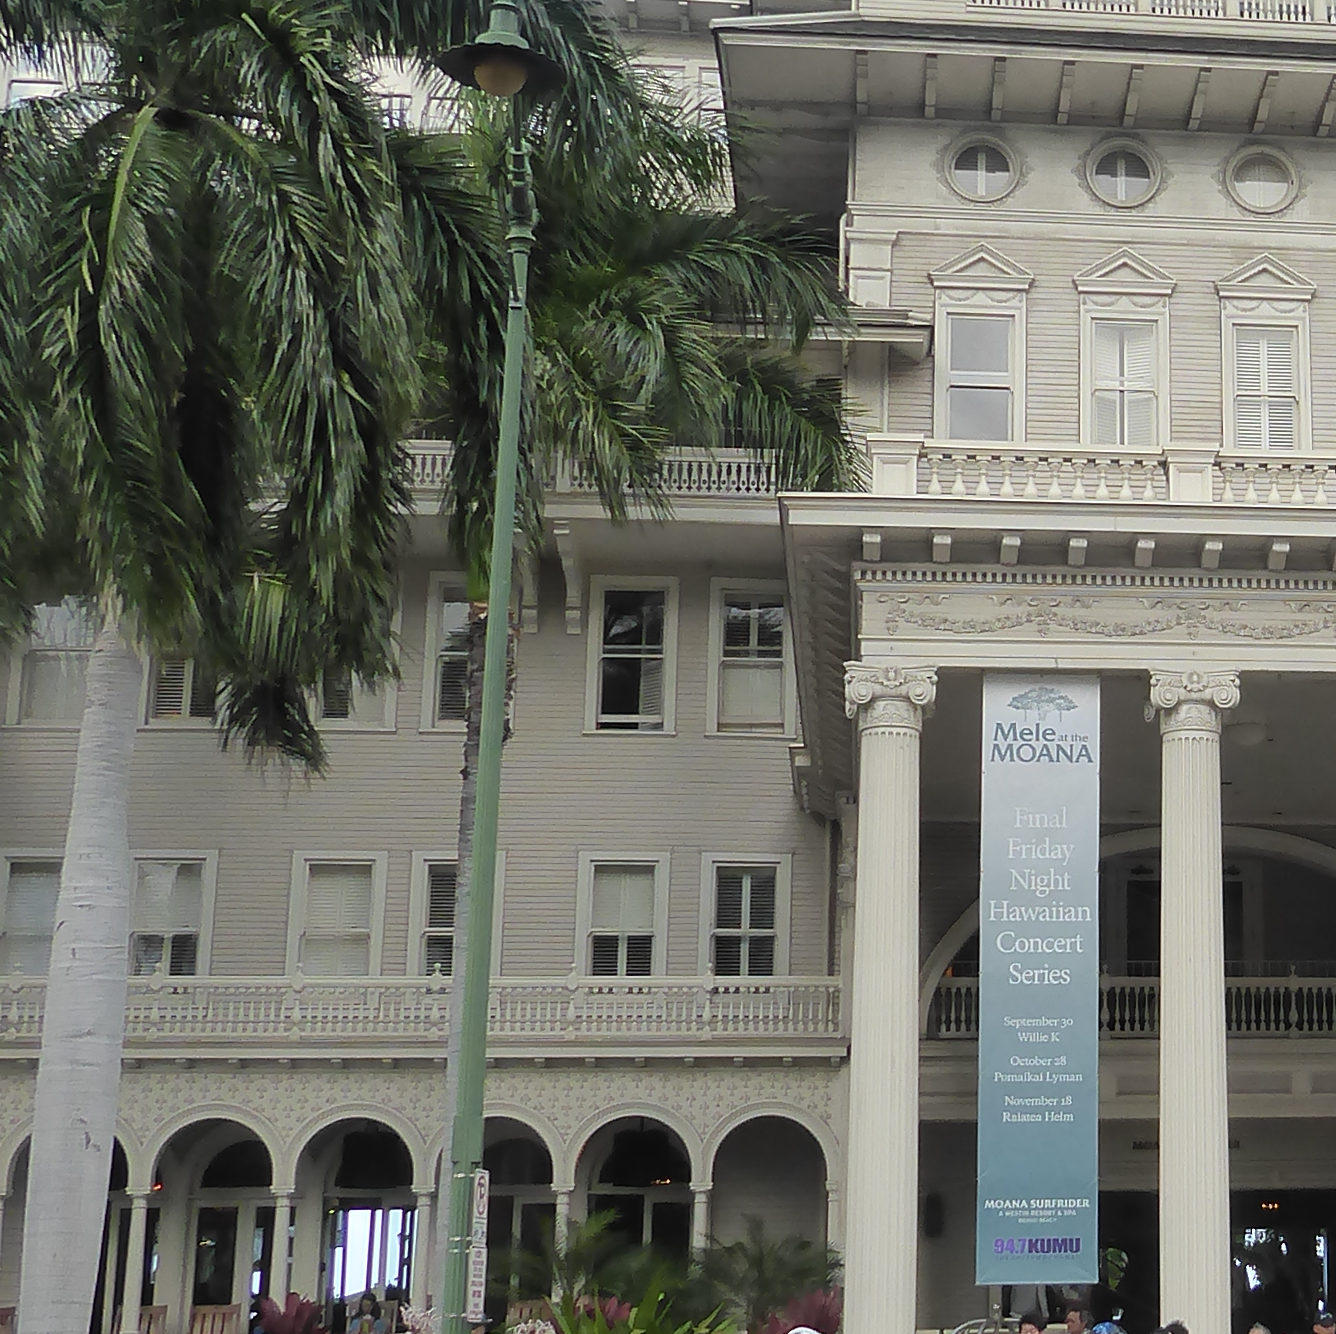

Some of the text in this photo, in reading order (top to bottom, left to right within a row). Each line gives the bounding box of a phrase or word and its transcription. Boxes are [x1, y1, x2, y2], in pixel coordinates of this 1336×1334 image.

[994, 722, 1089, 742] Mele at the
[990, 743, 1094, 763] MOANA
[1014, 806, 1068, 828] Final
[1007, 838, 1075, 866] Friday
[1009, 868, 1071, 897] Night
[988, 900, 1092, 921] Hawaiian
[996, 931, 1084, 953] Concert
[1009, 962, 1070, 984] Series
[1003, 1016, 1074, 1028] September 30
[1018, 1032, 1060, 1042] Willie K
[1010, 1055, 1052, 1066] October
[1046, 1072, 1083, 1084] Lyman
[1004, 1095, 1073, 1106] November 18
[1045, 1111, 1074, 1121] Helm
[984, 1198, 1090, 1209] MOANA SURFRIDER
